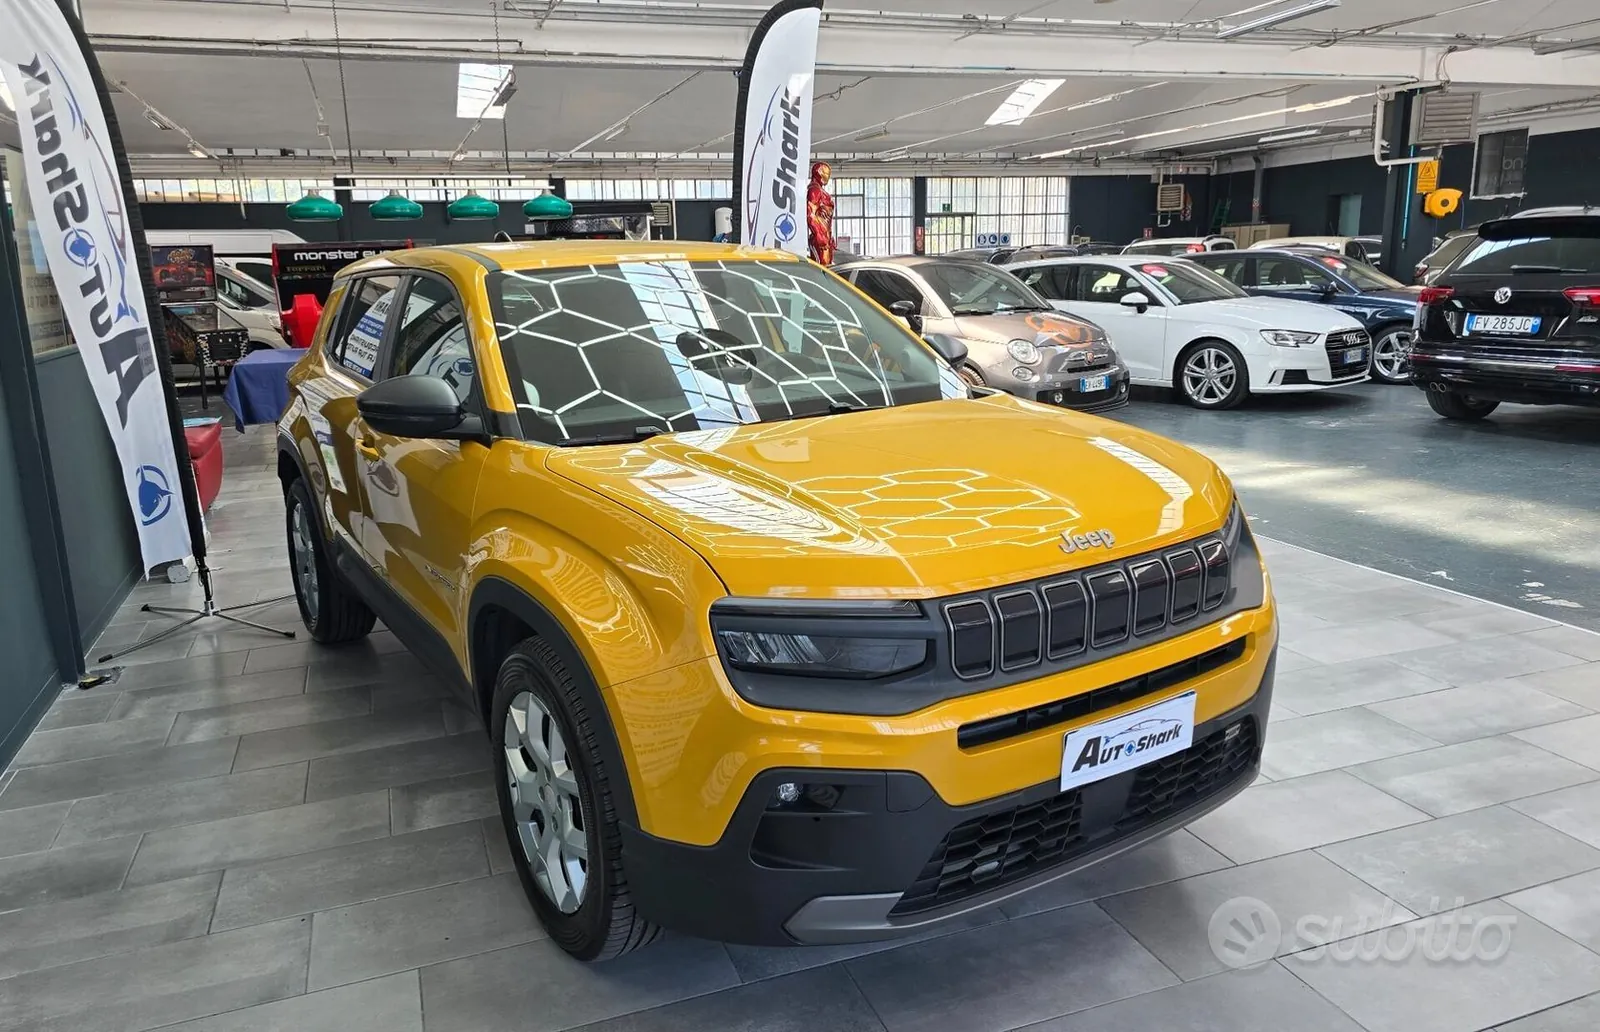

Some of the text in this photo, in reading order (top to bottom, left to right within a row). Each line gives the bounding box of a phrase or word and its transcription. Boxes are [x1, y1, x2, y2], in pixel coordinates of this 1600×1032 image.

[294, 249, 359, 261] monster
[1474, 316, 1531, 331] FV 285JC
[1058, 527, 1116, 554] Jeep
